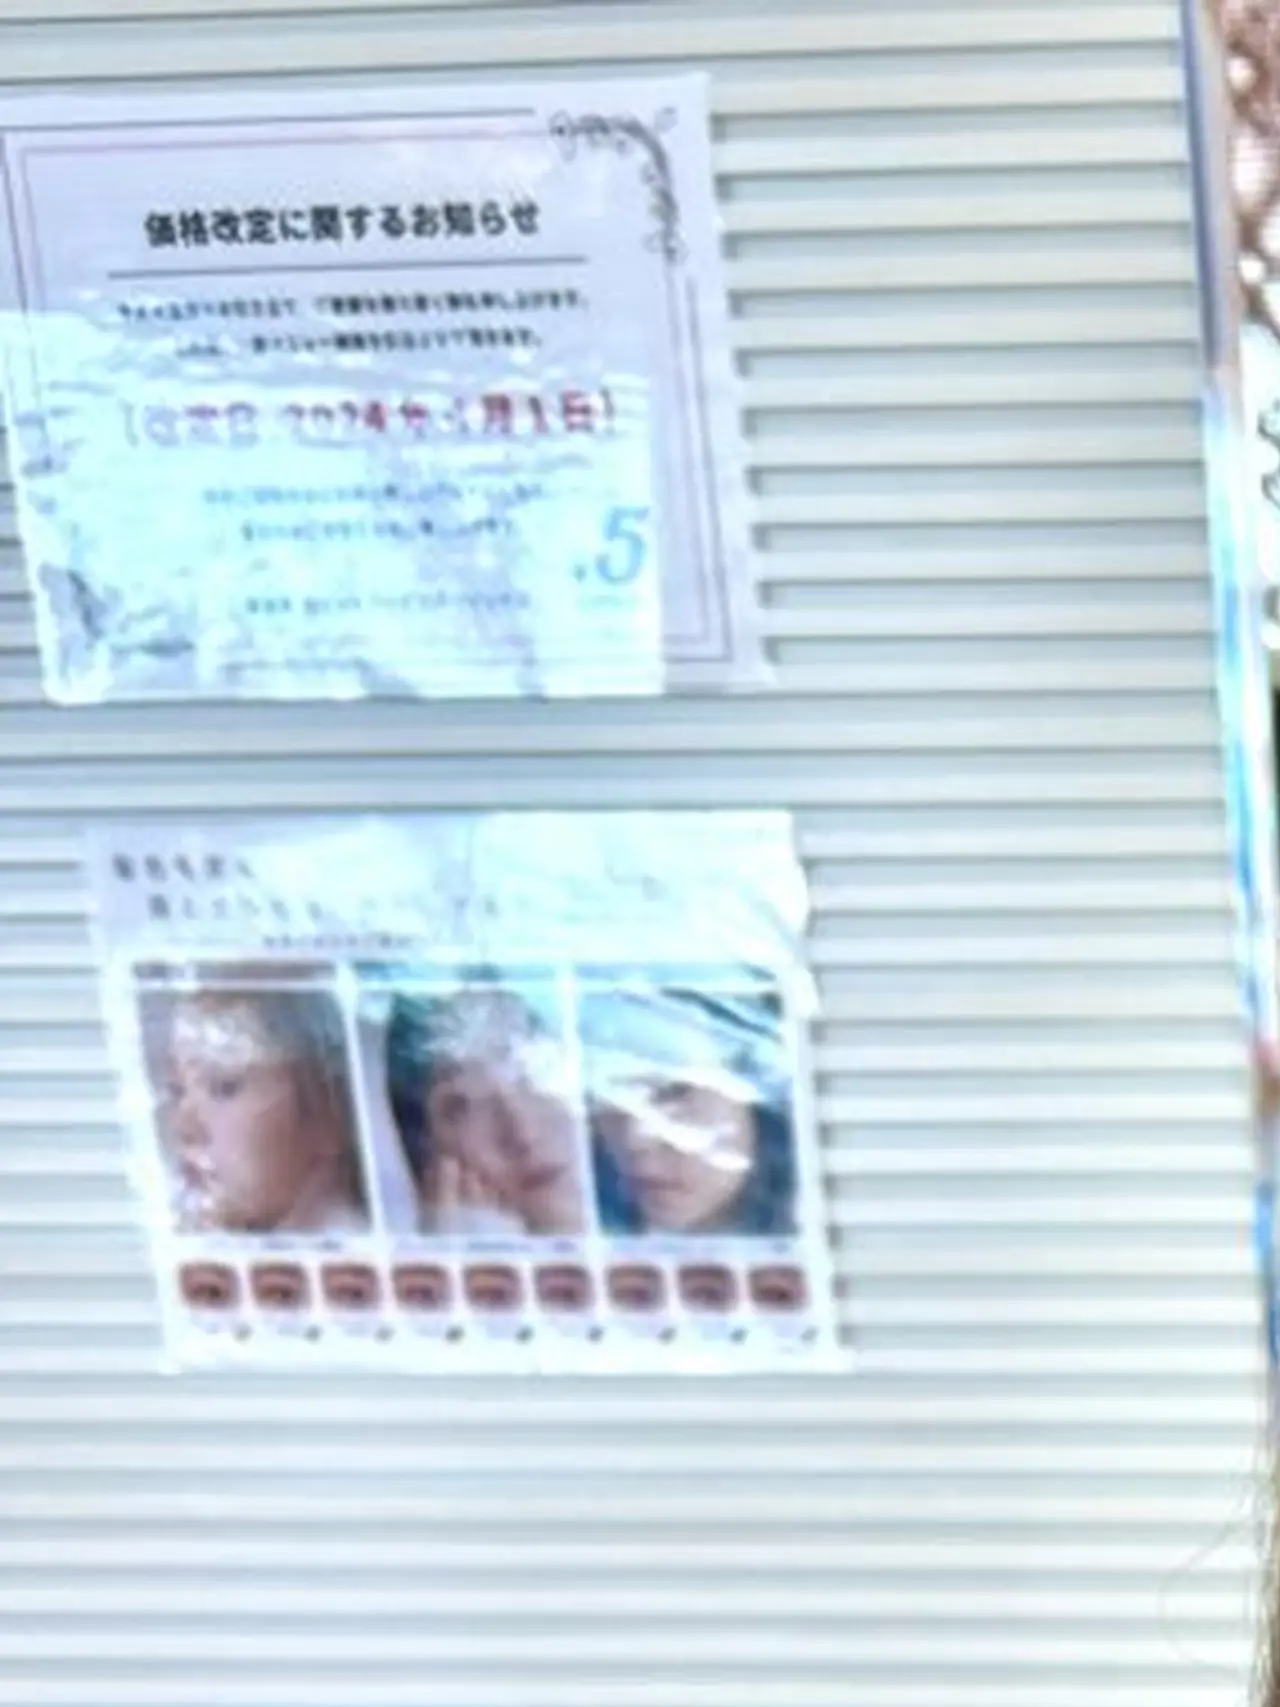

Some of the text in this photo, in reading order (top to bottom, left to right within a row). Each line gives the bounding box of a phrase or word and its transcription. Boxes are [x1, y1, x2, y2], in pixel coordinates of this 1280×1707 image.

[144, 200, 540, 248] 価格改定に関するお知らせ
